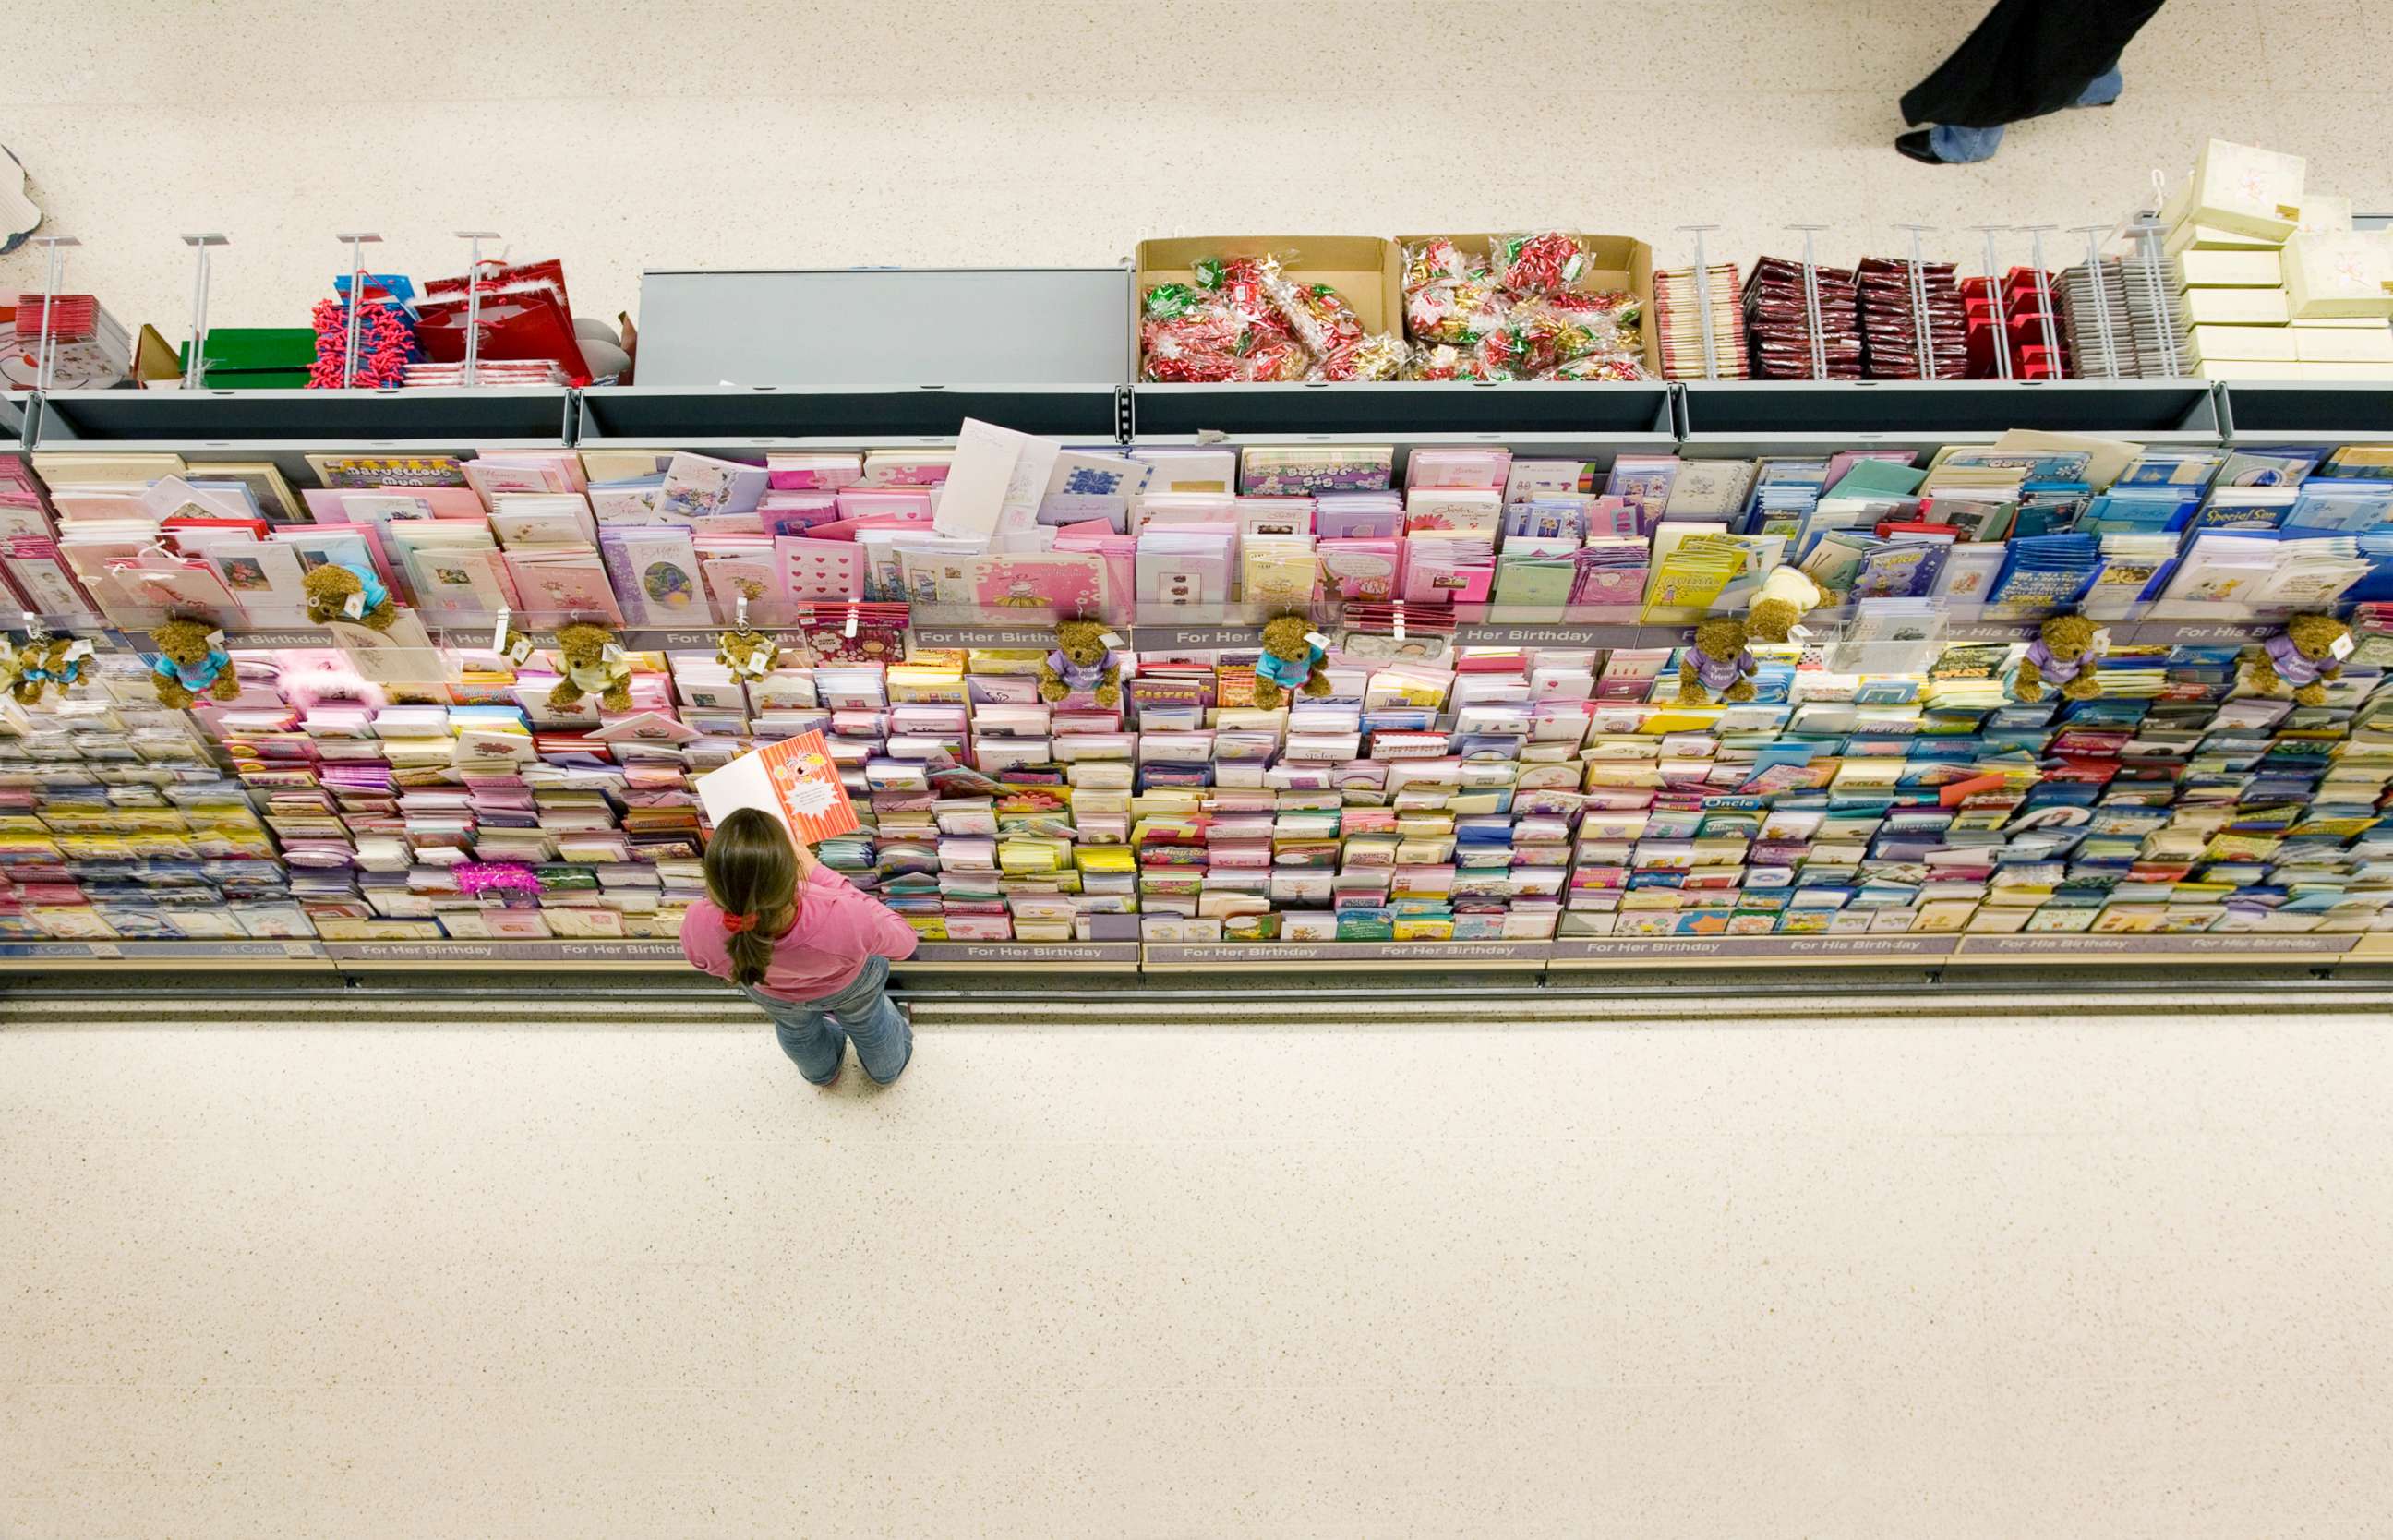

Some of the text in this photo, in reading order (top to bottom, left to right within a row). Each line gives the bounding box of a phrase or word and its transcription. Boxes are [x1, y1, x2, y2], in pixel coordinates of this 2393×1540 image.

[1970, 627, 2002, 637] His
[2174, 628, 2210, 638] For
[2213, 627, 2246, 637] His
[249, 634, 333, 645] Birthday
[456, 634, 492, 644] Her
[667, 633, 700, 644] For
[920, 632, 954, 643] For
[960, 632, 994, 642] Her
[1176, 632, 1209, 644] For
[1215, 632, 1251, 644] Her
[1467, 631, 1503, 641] Her
[1509, 631, 1593, 644] Birthday
[1587, 943, 1720, 953] For Her Birthday
[1790, 940, 1921, 951] For His Birthday
[1999, 940, 2129, 950] For His Birthday
[2191, 938, 2321, 948] For His Birthday
[221, 944, 238, 954] All
[238, 944, 283, 954] Cards
[361, 946, 492, 956] For Her Birthday
[562, 945, 685, 954] For Her Birthda
[968, 947, 1103, 957] For Her Birthday
[1184, 947, 1317, 957] For Her Birthday
[1381, 946, 1515, 956] For Her Birthday
